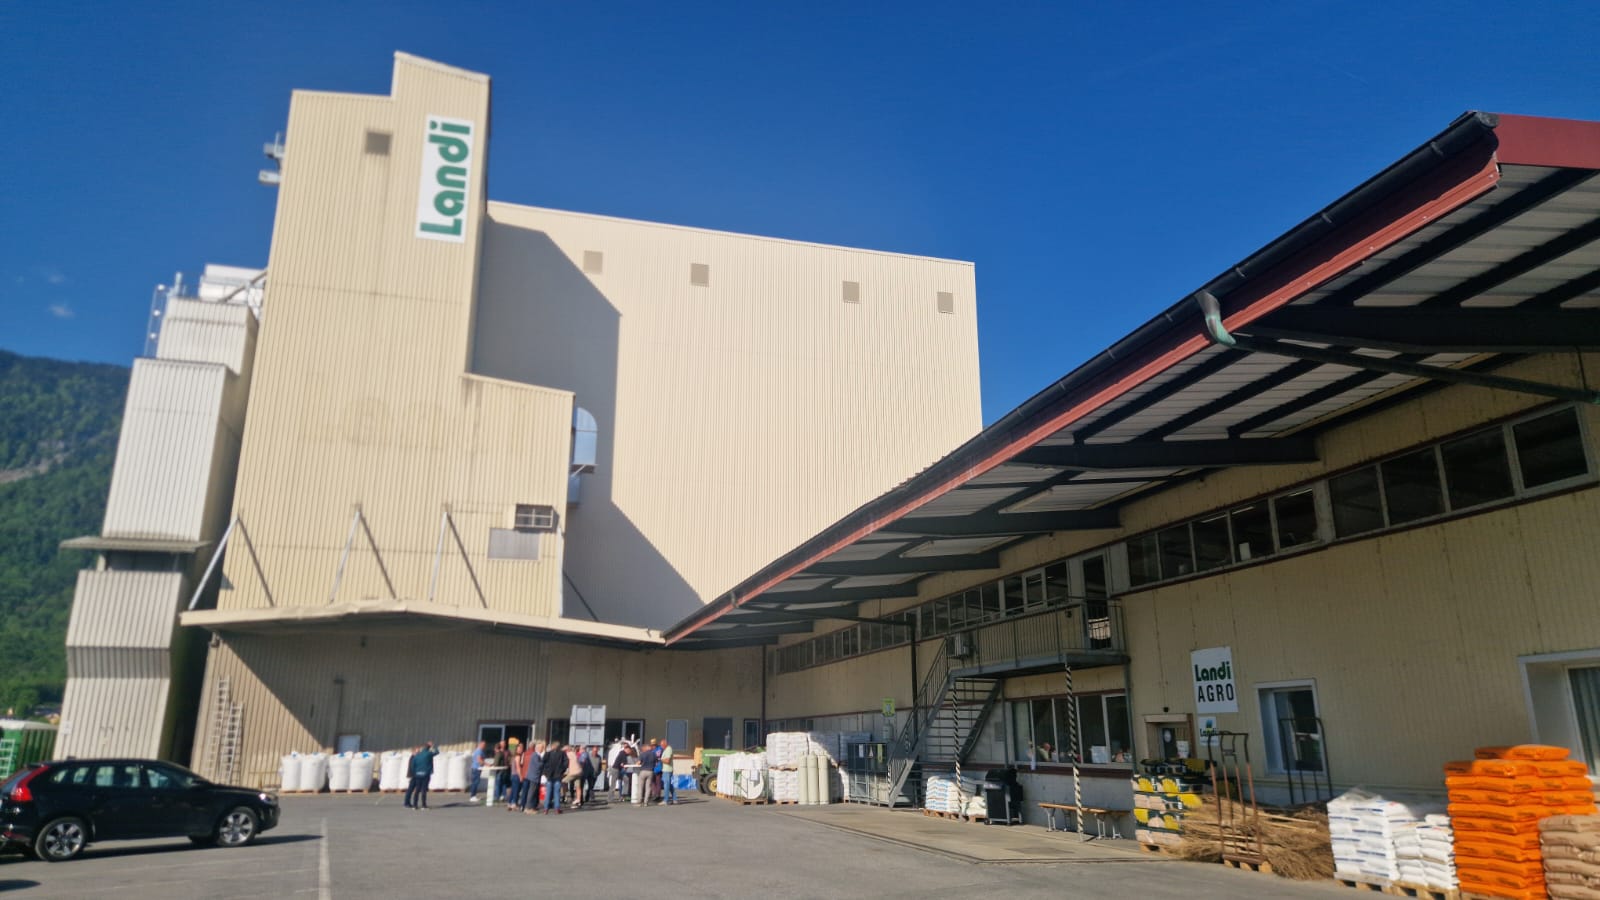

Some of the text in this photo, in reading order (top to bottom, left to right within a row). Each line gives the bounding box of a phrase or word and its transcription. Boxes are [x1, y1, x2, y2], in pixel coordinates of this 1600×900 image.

[420, 120, 471, 236] Landi
[1194, 661, 1232, 682] Landi
[1198, 683, 1235, 702] AGRO
